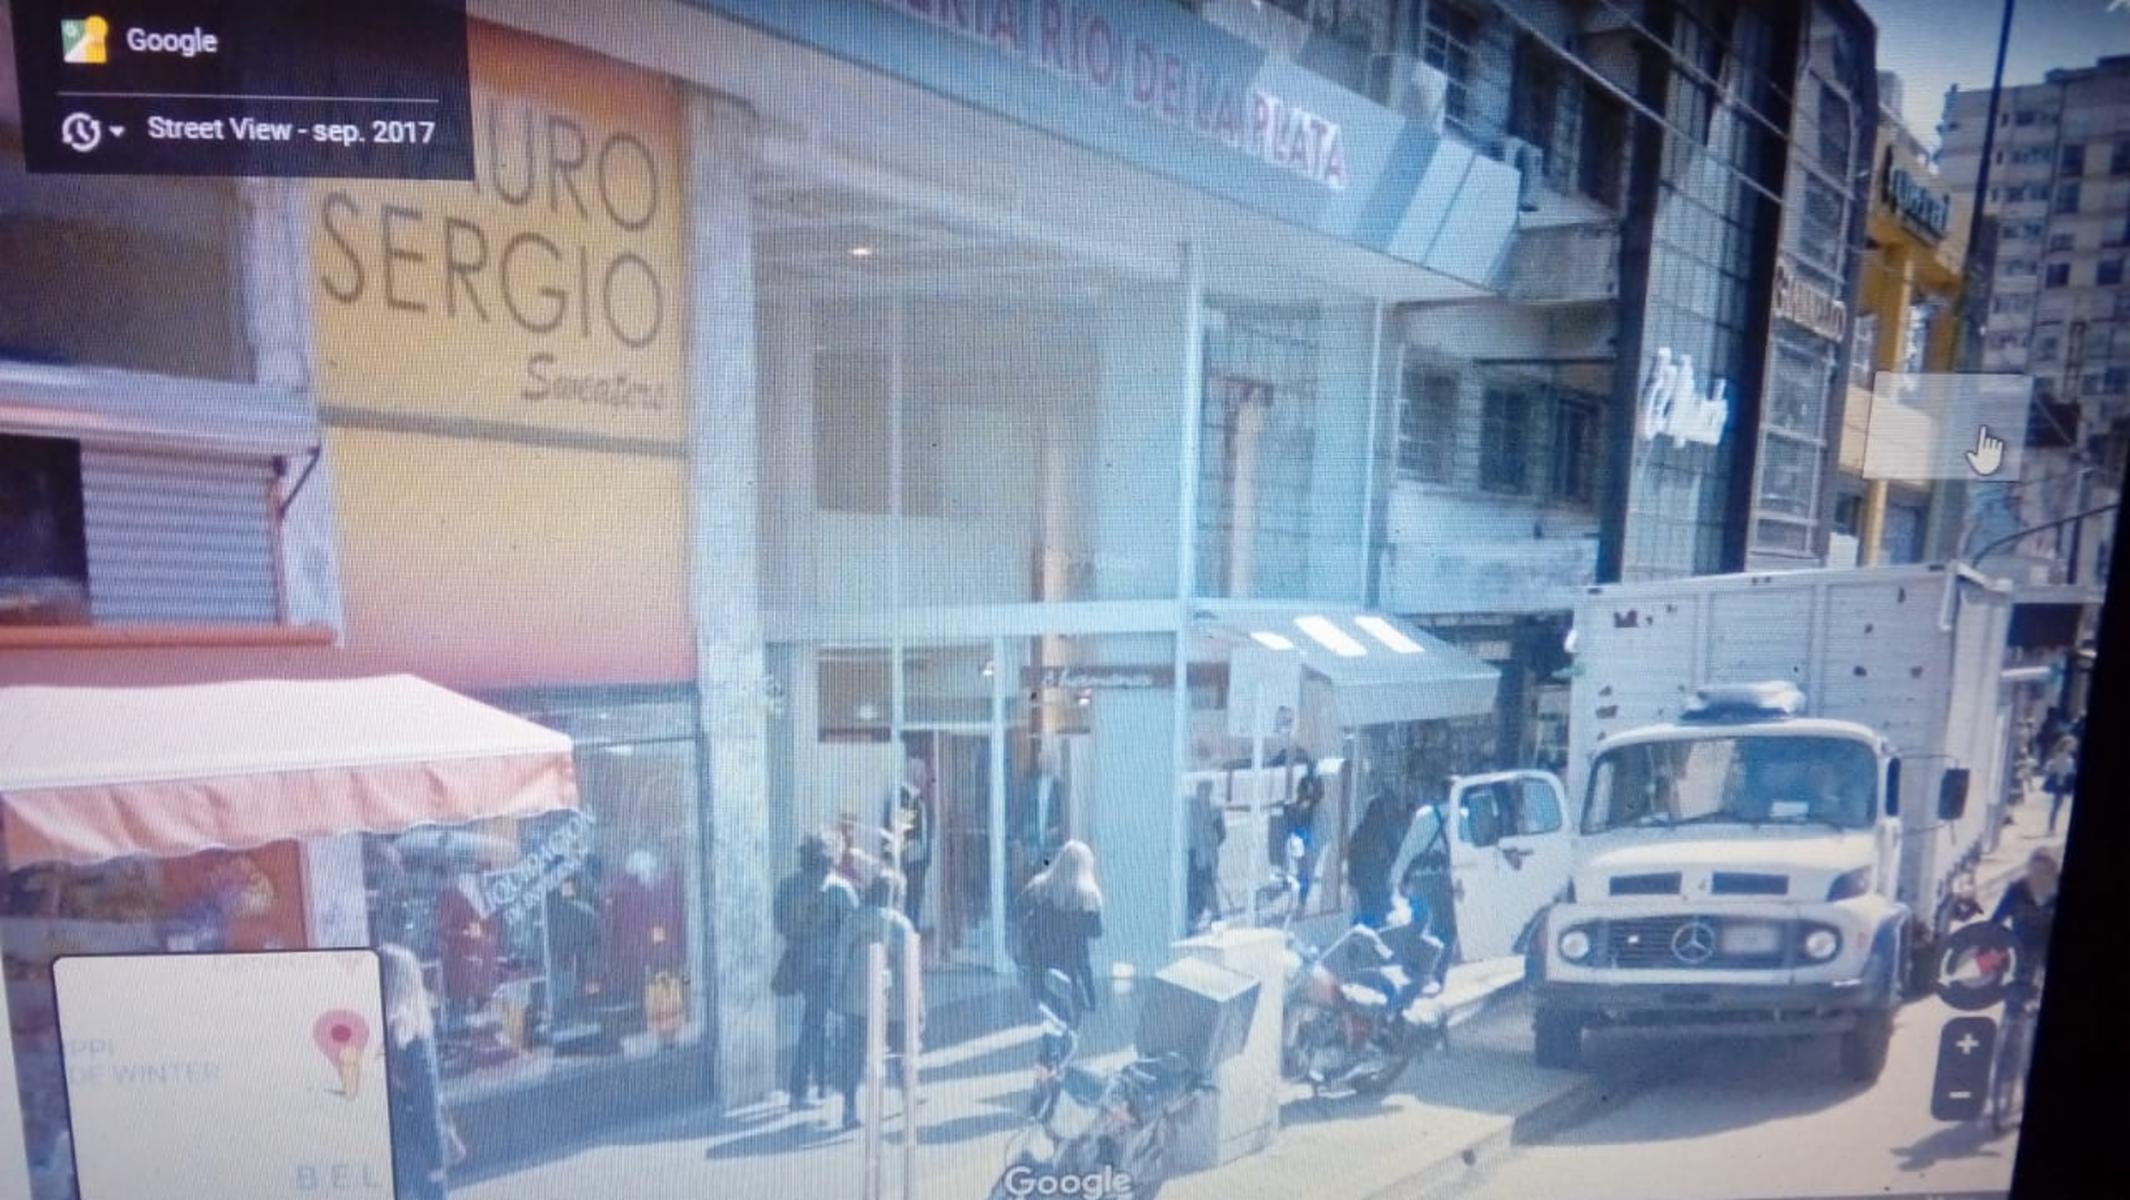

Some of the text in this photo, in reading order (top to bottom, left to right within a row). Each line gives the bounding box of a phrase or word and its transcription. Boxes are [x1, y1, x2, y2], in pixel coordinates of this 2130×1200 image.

[127, 27, 218, 57] Google
[1038, 0, 1120, 87] RIO
[1131, 38, 1182, 116] DE
[1252, 87, 1347, 186] PLATA
[147, 115, 224, 140] Street
[230, 117, 292, 142] View
[312, 122, 366, 147] sep.
[372, 120, 436, 144] 2017
[474, 98, 658, 232] URO
[320, 191, 665, 349] SERGIO
[112, 1062, 222, 1085] WINTER
[1004, 1163, 1133, 1200] Google
